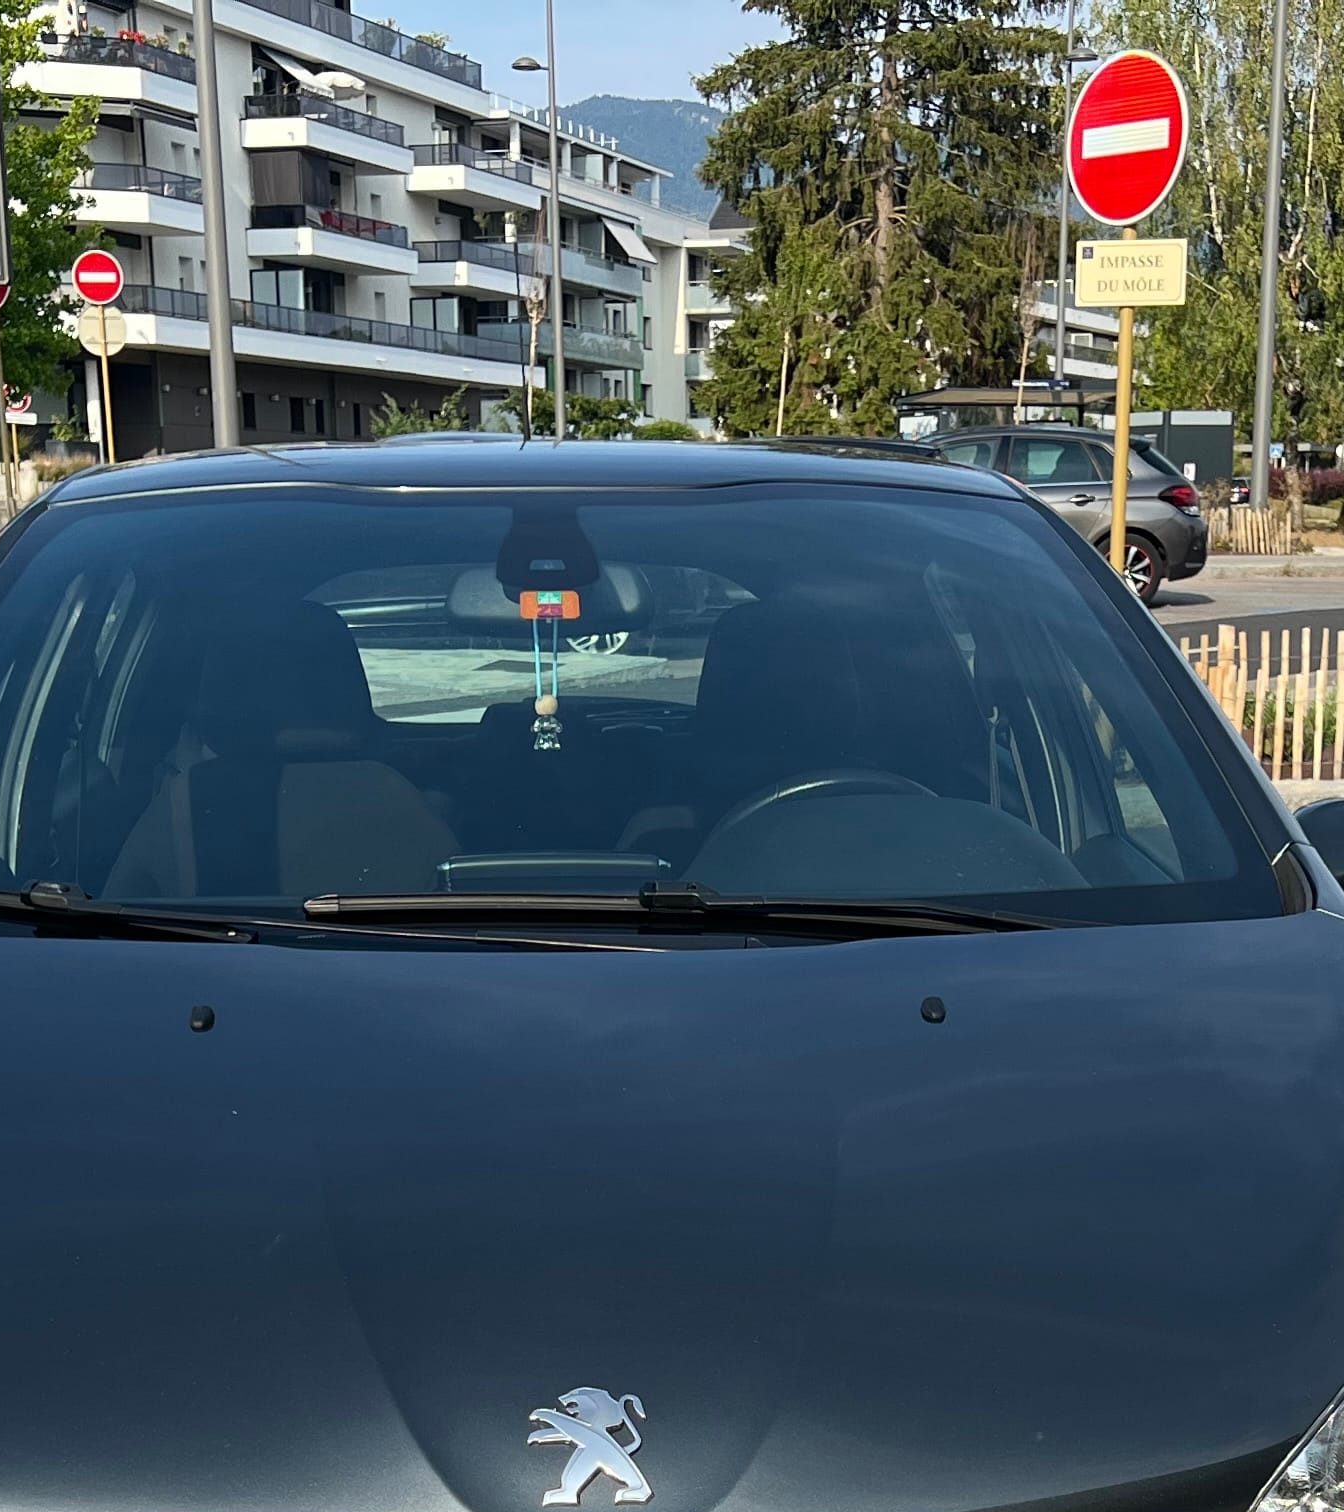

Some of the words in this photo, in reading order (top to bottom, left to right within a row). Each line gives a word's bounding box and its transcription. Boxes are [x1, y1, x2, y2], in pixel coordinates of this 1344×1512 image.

[1100, 254, 1164, 269] IMPASSE
[1097, 279, 1119, 293] DU
[1123, 276, 1166, 292] MÔLE
